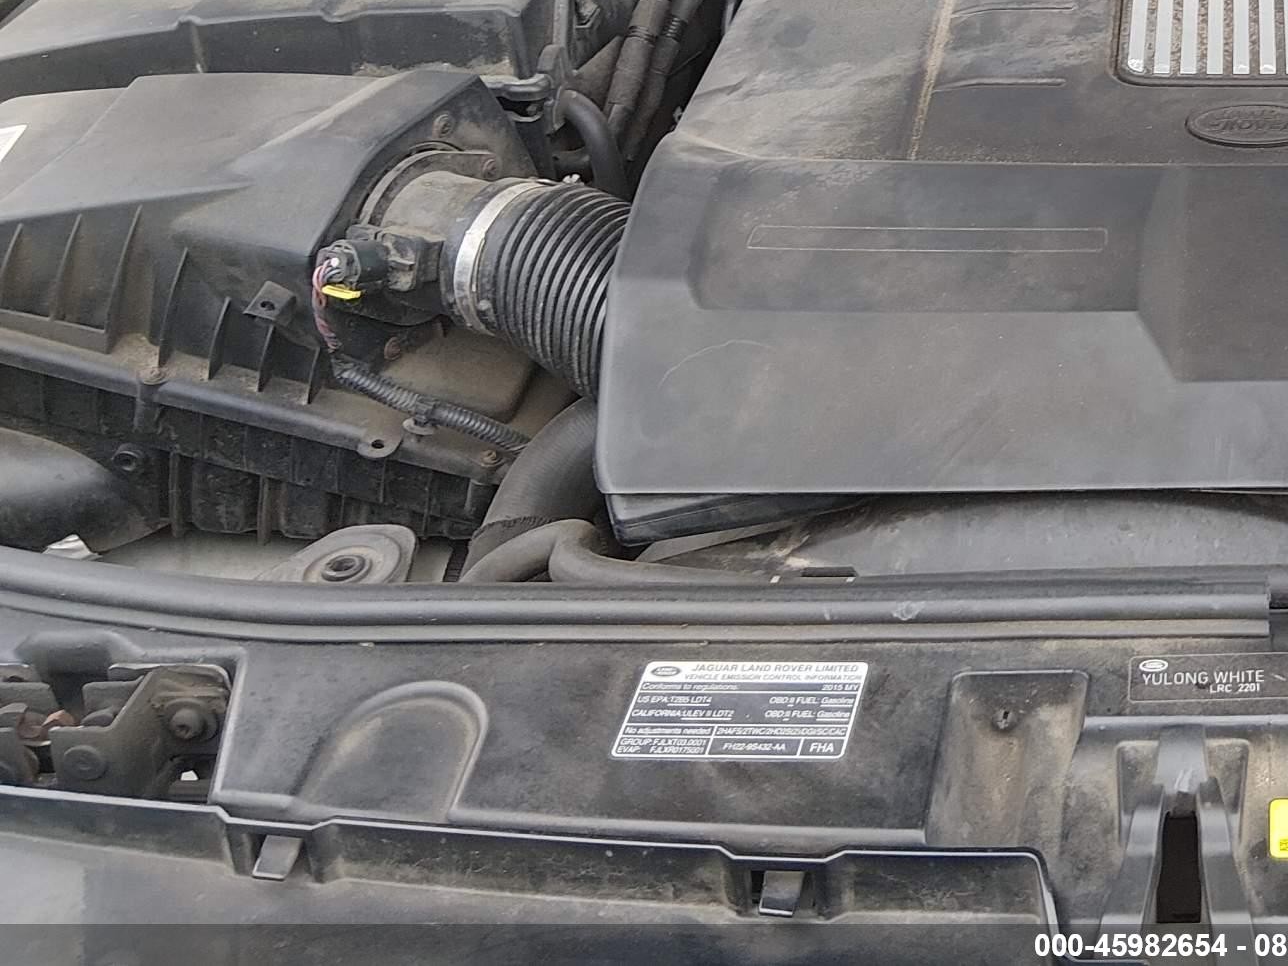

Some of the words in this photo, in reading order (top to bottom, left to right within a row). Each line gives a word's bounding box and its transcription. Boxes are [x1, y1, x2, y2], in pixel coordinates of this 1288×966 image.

[691, 664, 738, 672] JAGUAR
[740, 664, 771, 672] LAND
[774, 664, 811, 672] ROVER
[815, 664, 859, 672] LIMITED
[1142, 672, 1208, 685] YULONG
[1213, 670, 1265, 684] WHITE
[642, 682, 682, 690] Conforms
[1210, 684, 1233, 693] LRC
[1237, 683, 1261, 693] 2201
[637, 695, 650, 703] US
[821, 696, 855, 704] Gasoline
[817, 710, 850, 718] Gasoline
[637, 727, 682, 735] adjustments
[809, 742, 834, 752] FHA
